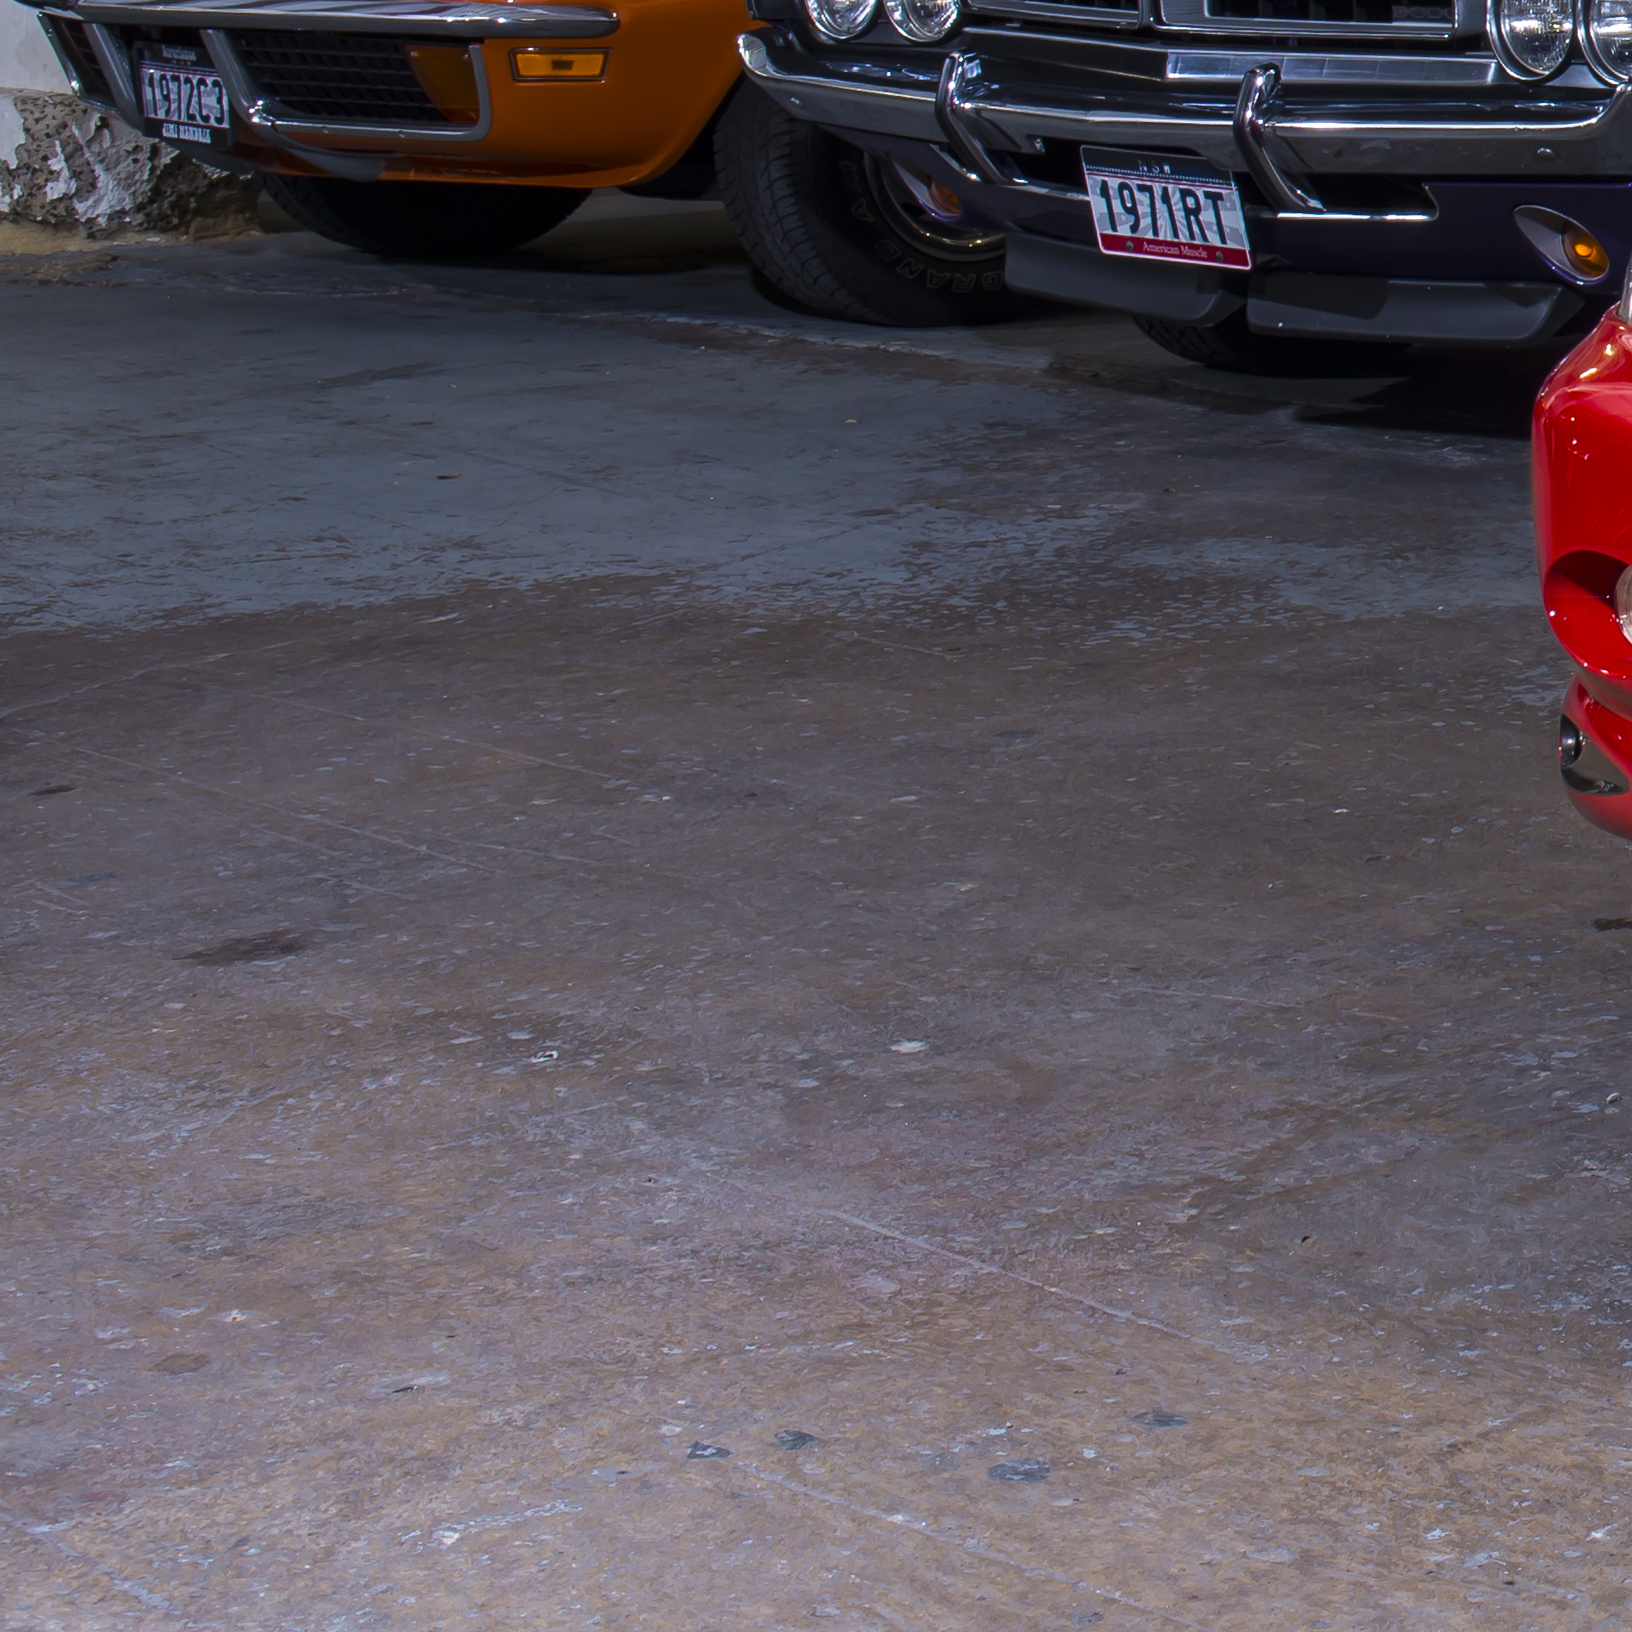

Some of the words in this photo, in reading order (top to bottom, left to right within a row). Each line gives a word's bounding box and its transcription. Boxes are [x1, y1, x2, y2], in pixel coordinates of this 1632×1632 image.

[148, 69, 225, 125] 1972C3
[1099, 178, 1228, 245] 1971RT
[873, 239, 1005, 294] GRAND
[1142, 241, 1180, 255] American
[1180, 245, 1209, 259] Muscle
